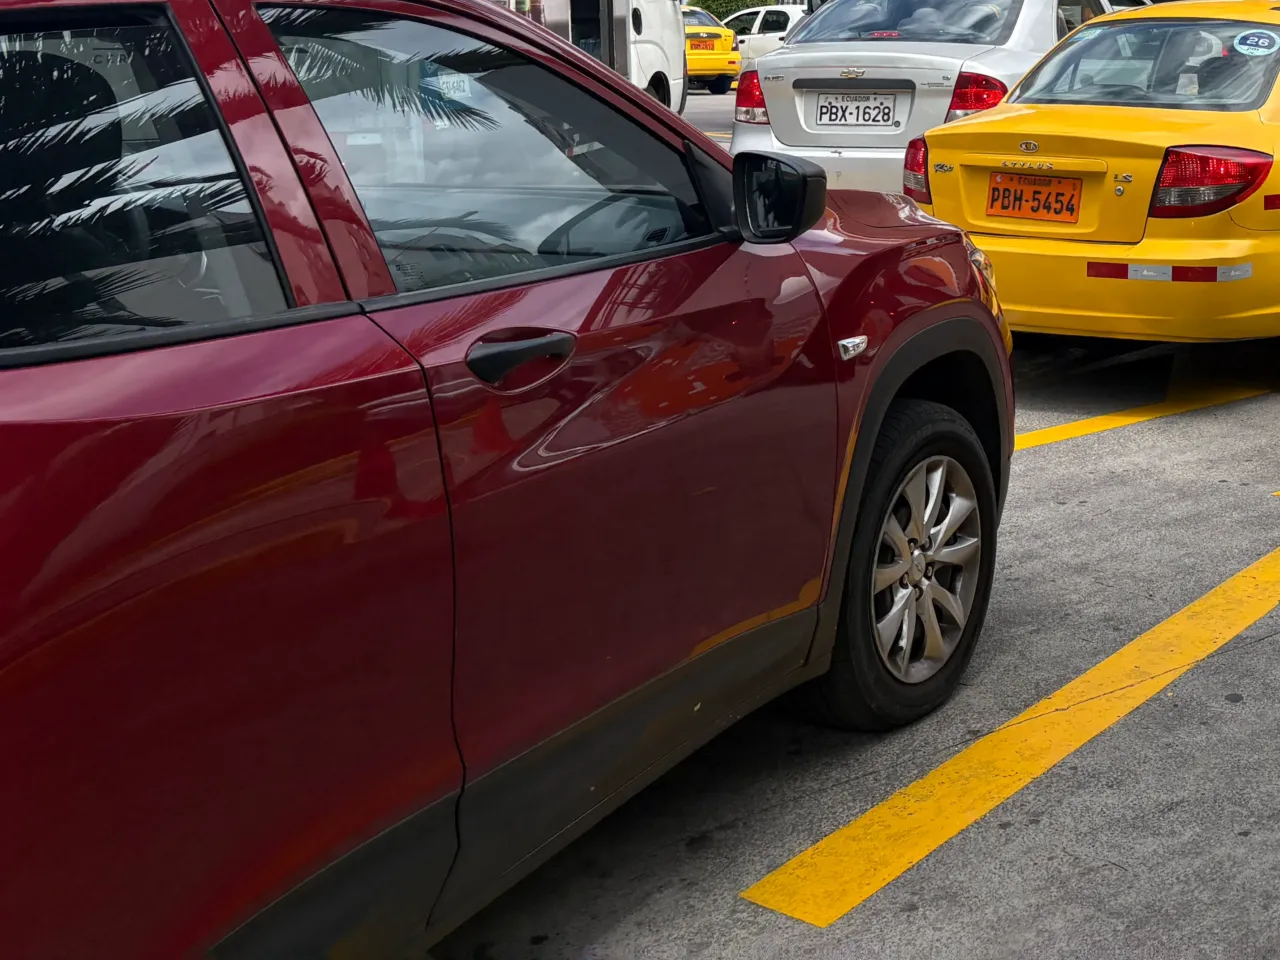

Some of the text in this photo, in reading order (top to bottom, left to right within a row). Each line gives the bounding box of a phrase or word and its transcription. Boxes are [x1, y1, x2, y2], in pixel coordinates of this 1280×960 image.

[1246, 36, 1270, 47] 26
[841, 94, 871, 103] ECUADOR
[818, 105, 892, 123] PBX-1628
[1021, 142, 1038, 151] KIA
[1001, 160, 1054, 170] STYLUS
[989, 186, 1076, 217] PBH-5454
